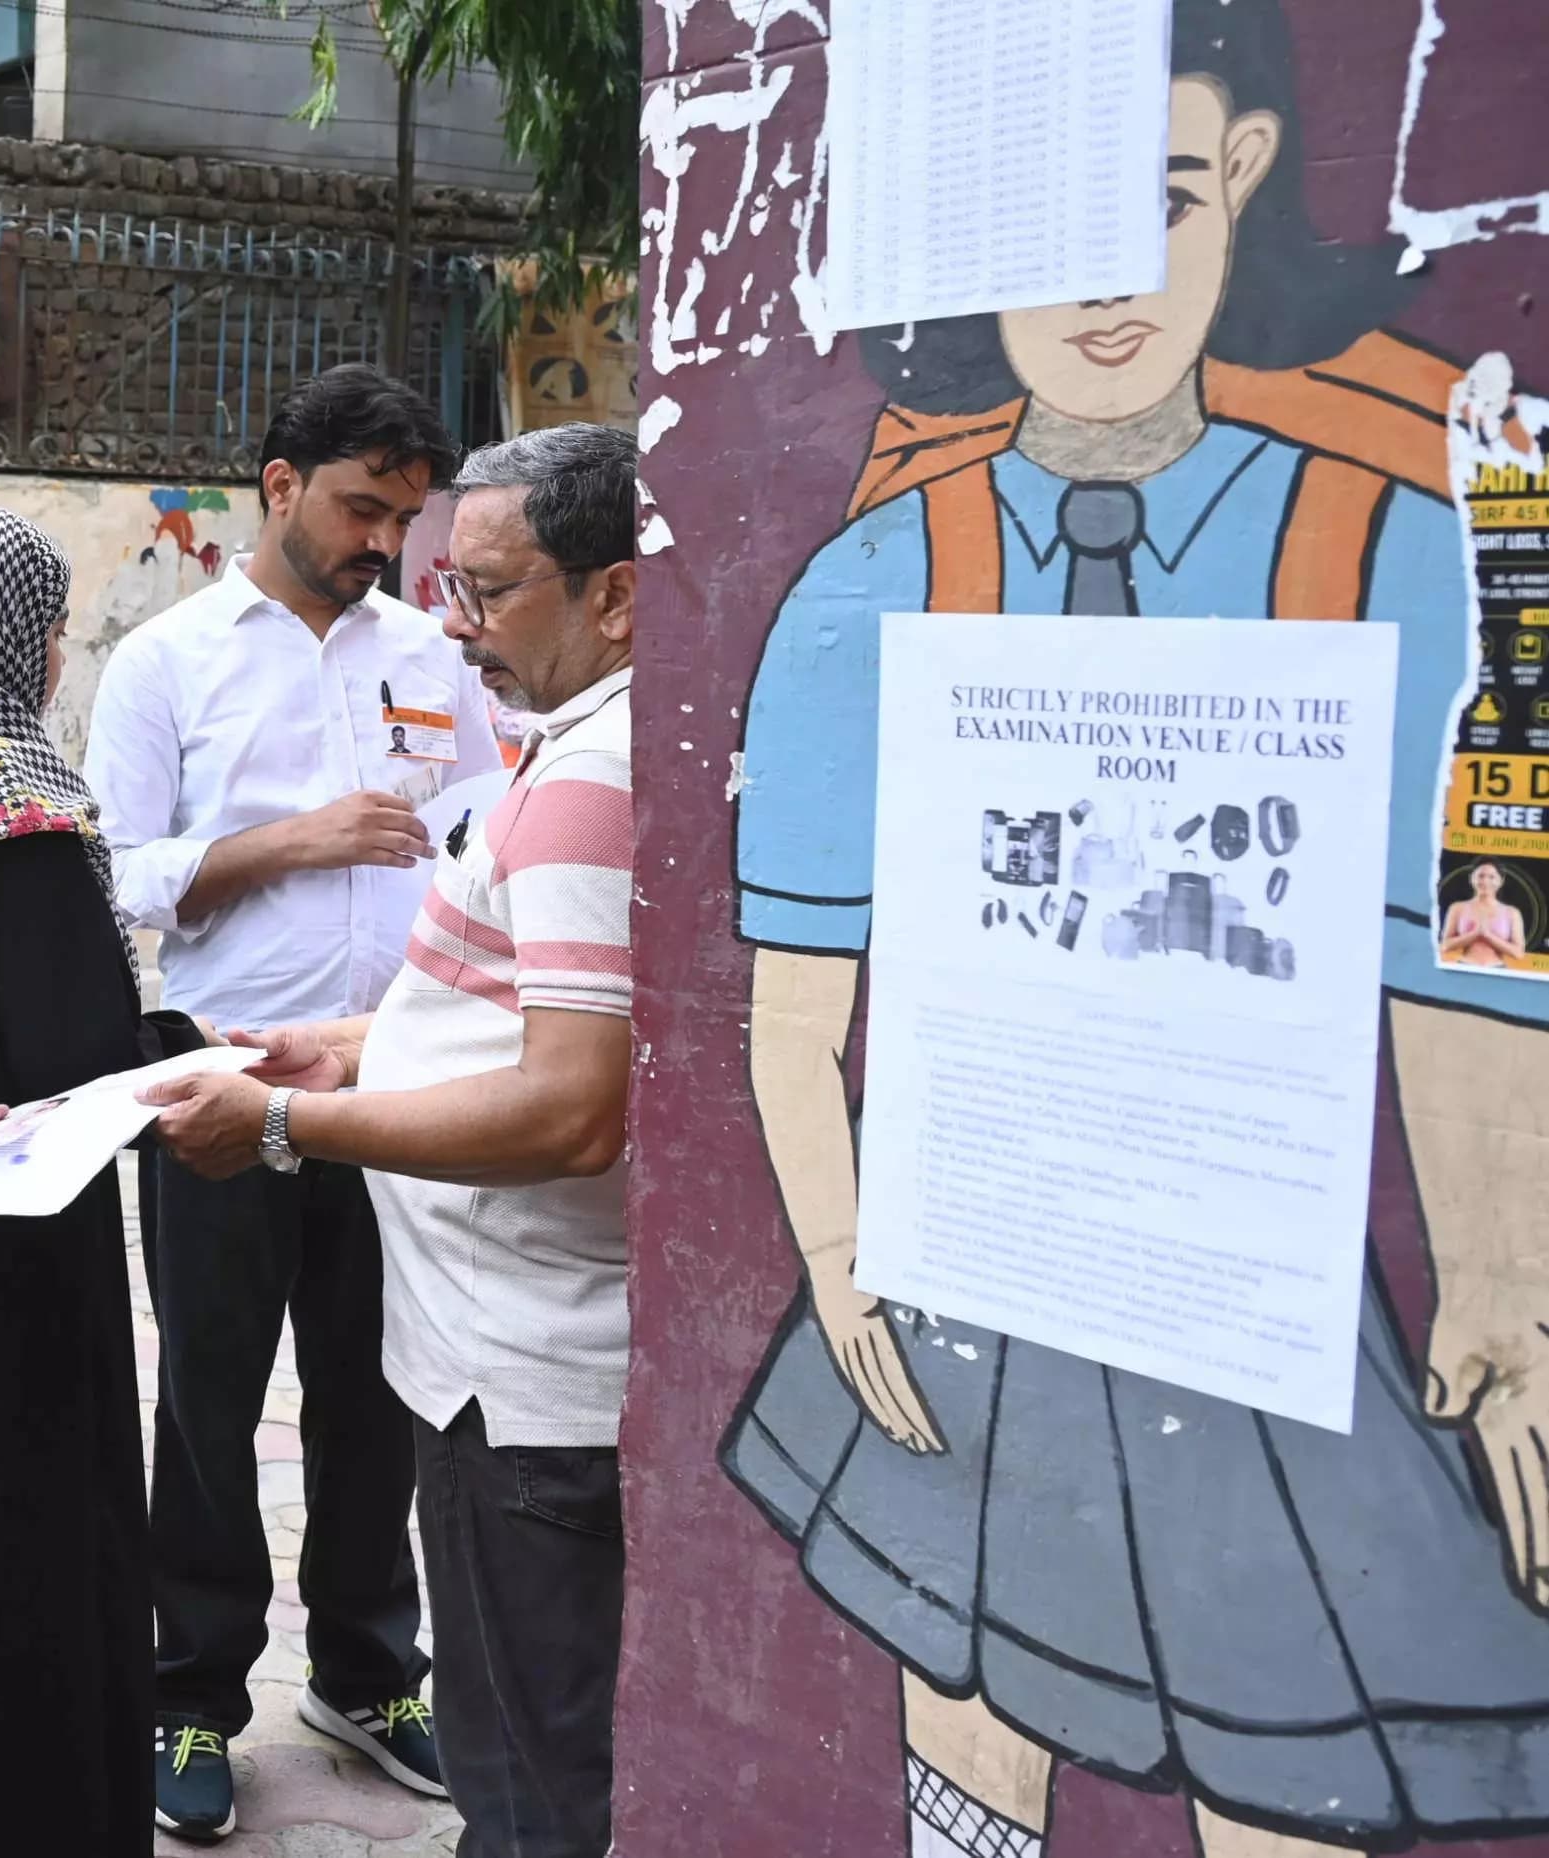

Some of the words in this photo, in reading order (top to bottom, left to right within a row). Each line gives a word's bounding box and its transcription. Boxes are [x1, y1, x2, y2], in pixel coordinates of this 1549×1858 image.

[951, 685, 1073, 712] STRICTLY
[1081, 691, 1245, 720] PROHIBITED
[1255, 697, 1282, 722] IN
[1294, 698, 1352, 726] THE
[955, 716, 1132, 748] EXAMINATION
[1141, 726, 1231, 753] VENUE
[1254, 731, 1346, 760] CLASS
[1097, 756, 1177, 783] ROOM
[1467, 761, 1511, 797] 15
[1472, 803, 1542, 829] FREE
